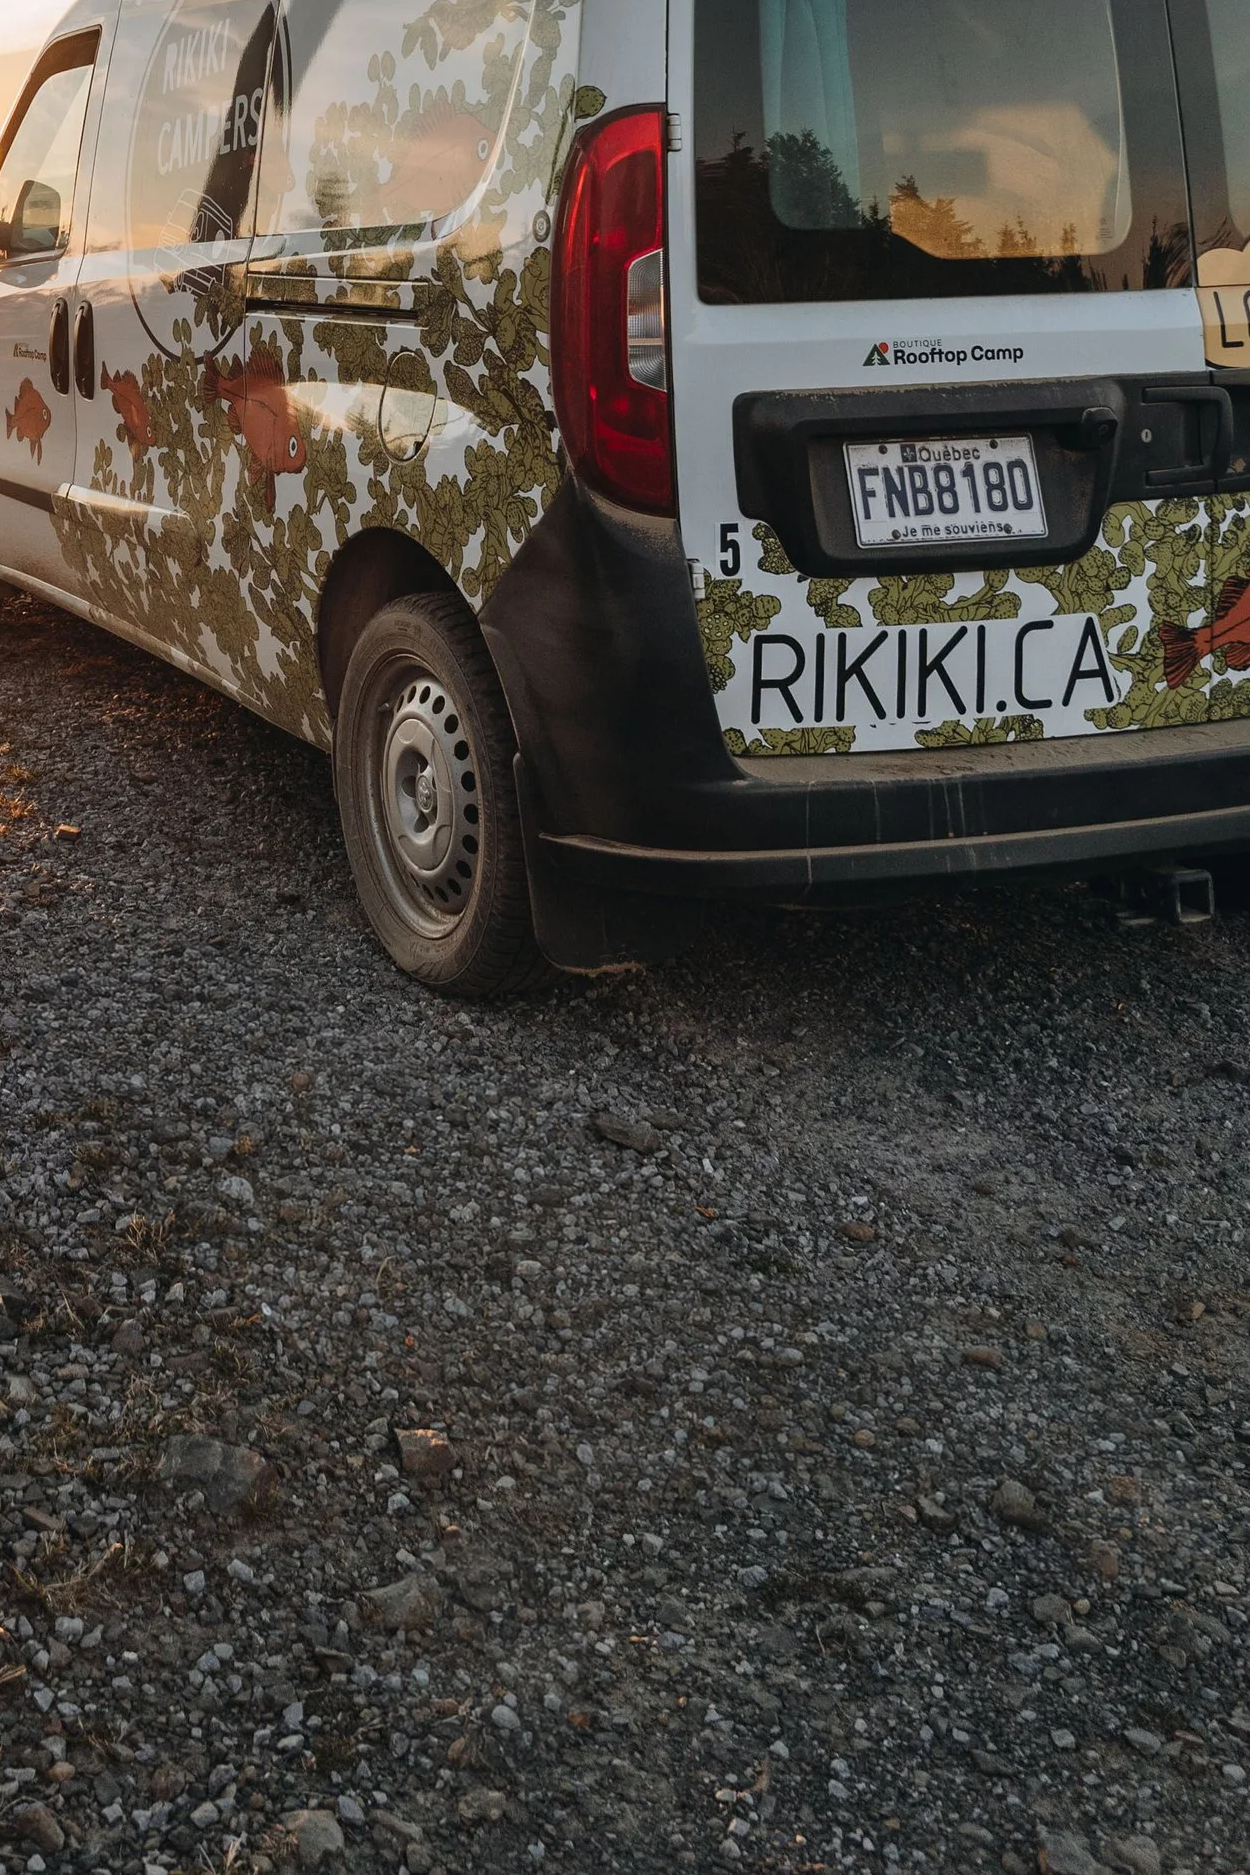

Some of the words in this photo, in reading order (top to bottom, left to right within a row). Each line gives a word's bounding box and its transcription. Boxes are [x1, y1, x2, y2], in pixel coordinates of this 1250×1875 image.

[162, 17, 231, 95] RIKIKI
[157, 86, 265, 176] CAMPERS
[892, 338, 942, 349] BOUTIQUE
[1212, 289, 1250, 349] L
[893, 347, 968, 366] Rooftop
[971, 345, 1024, 364] Camp
[918, 444, 981, 463] Québec
[856, 460, 1034, 521] FNB8180
[719, 522, 741, 577] 5
[902, 525, 917, 538] Je
[921, 525, 941, 537] me
[944, 522, 1004, 536] souviens
[750, 615, 1116, 725] RIKIKI.CA
